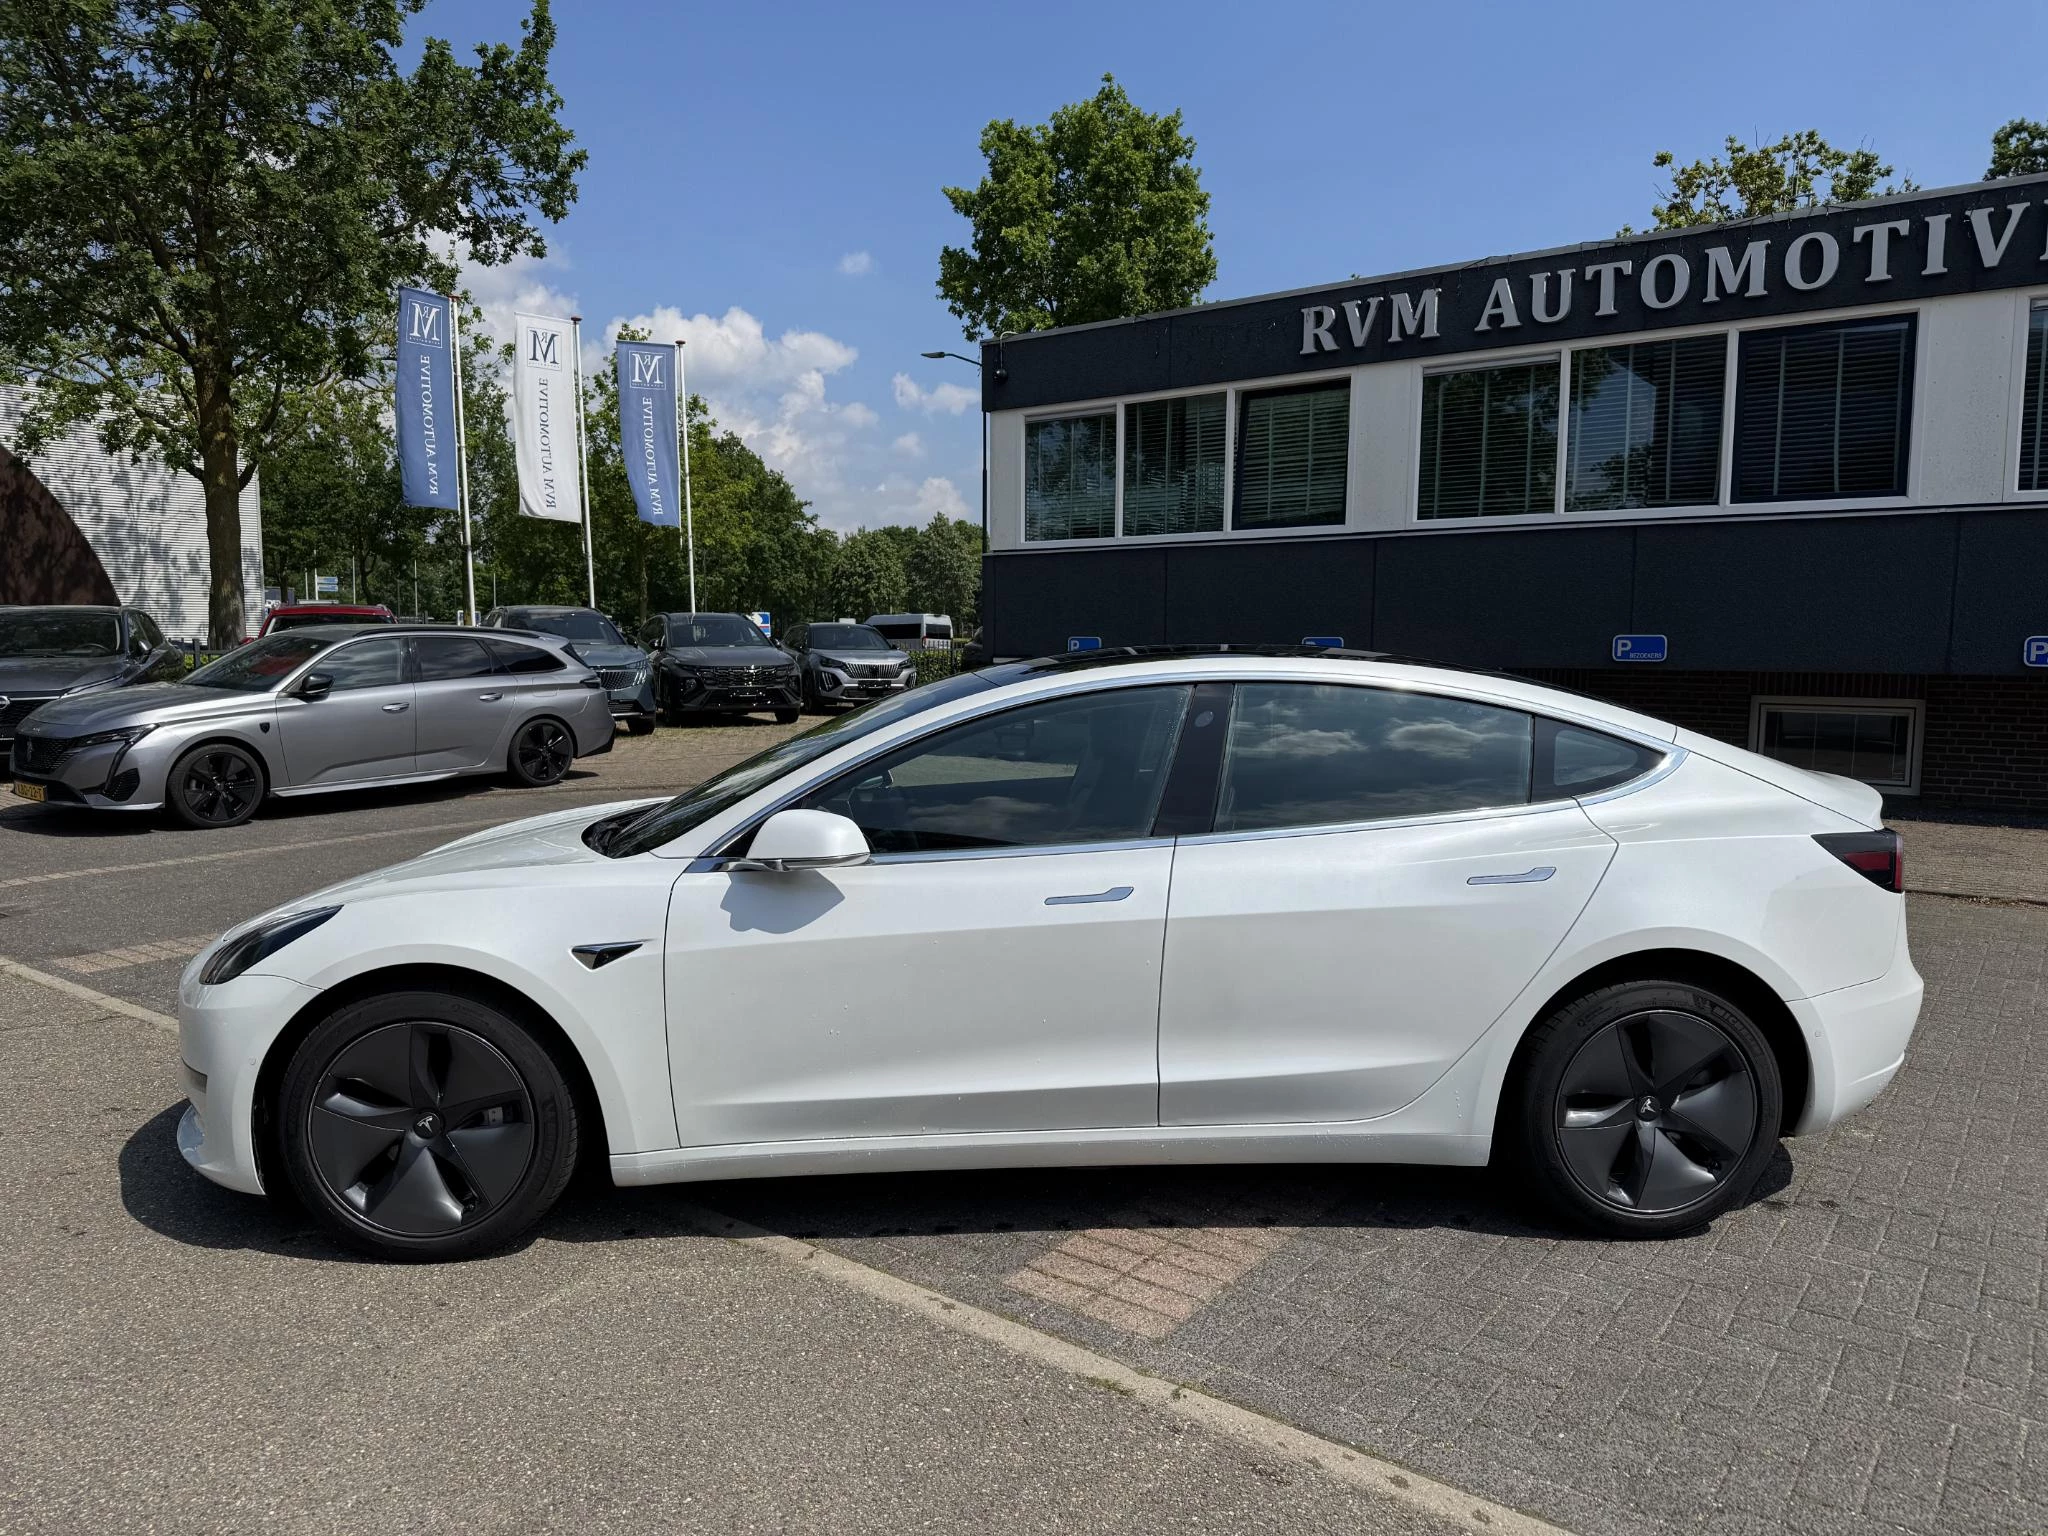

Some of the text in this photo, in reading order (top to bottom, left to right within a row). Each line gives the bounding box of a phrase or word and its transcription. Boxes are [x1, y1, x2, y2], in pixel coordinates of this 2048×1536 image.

[1300, 199, 2048, 355] RVM AUTOMOTIV
[1617, 639, 1632, 657] P
[2030, 641, 2048, 662] P
